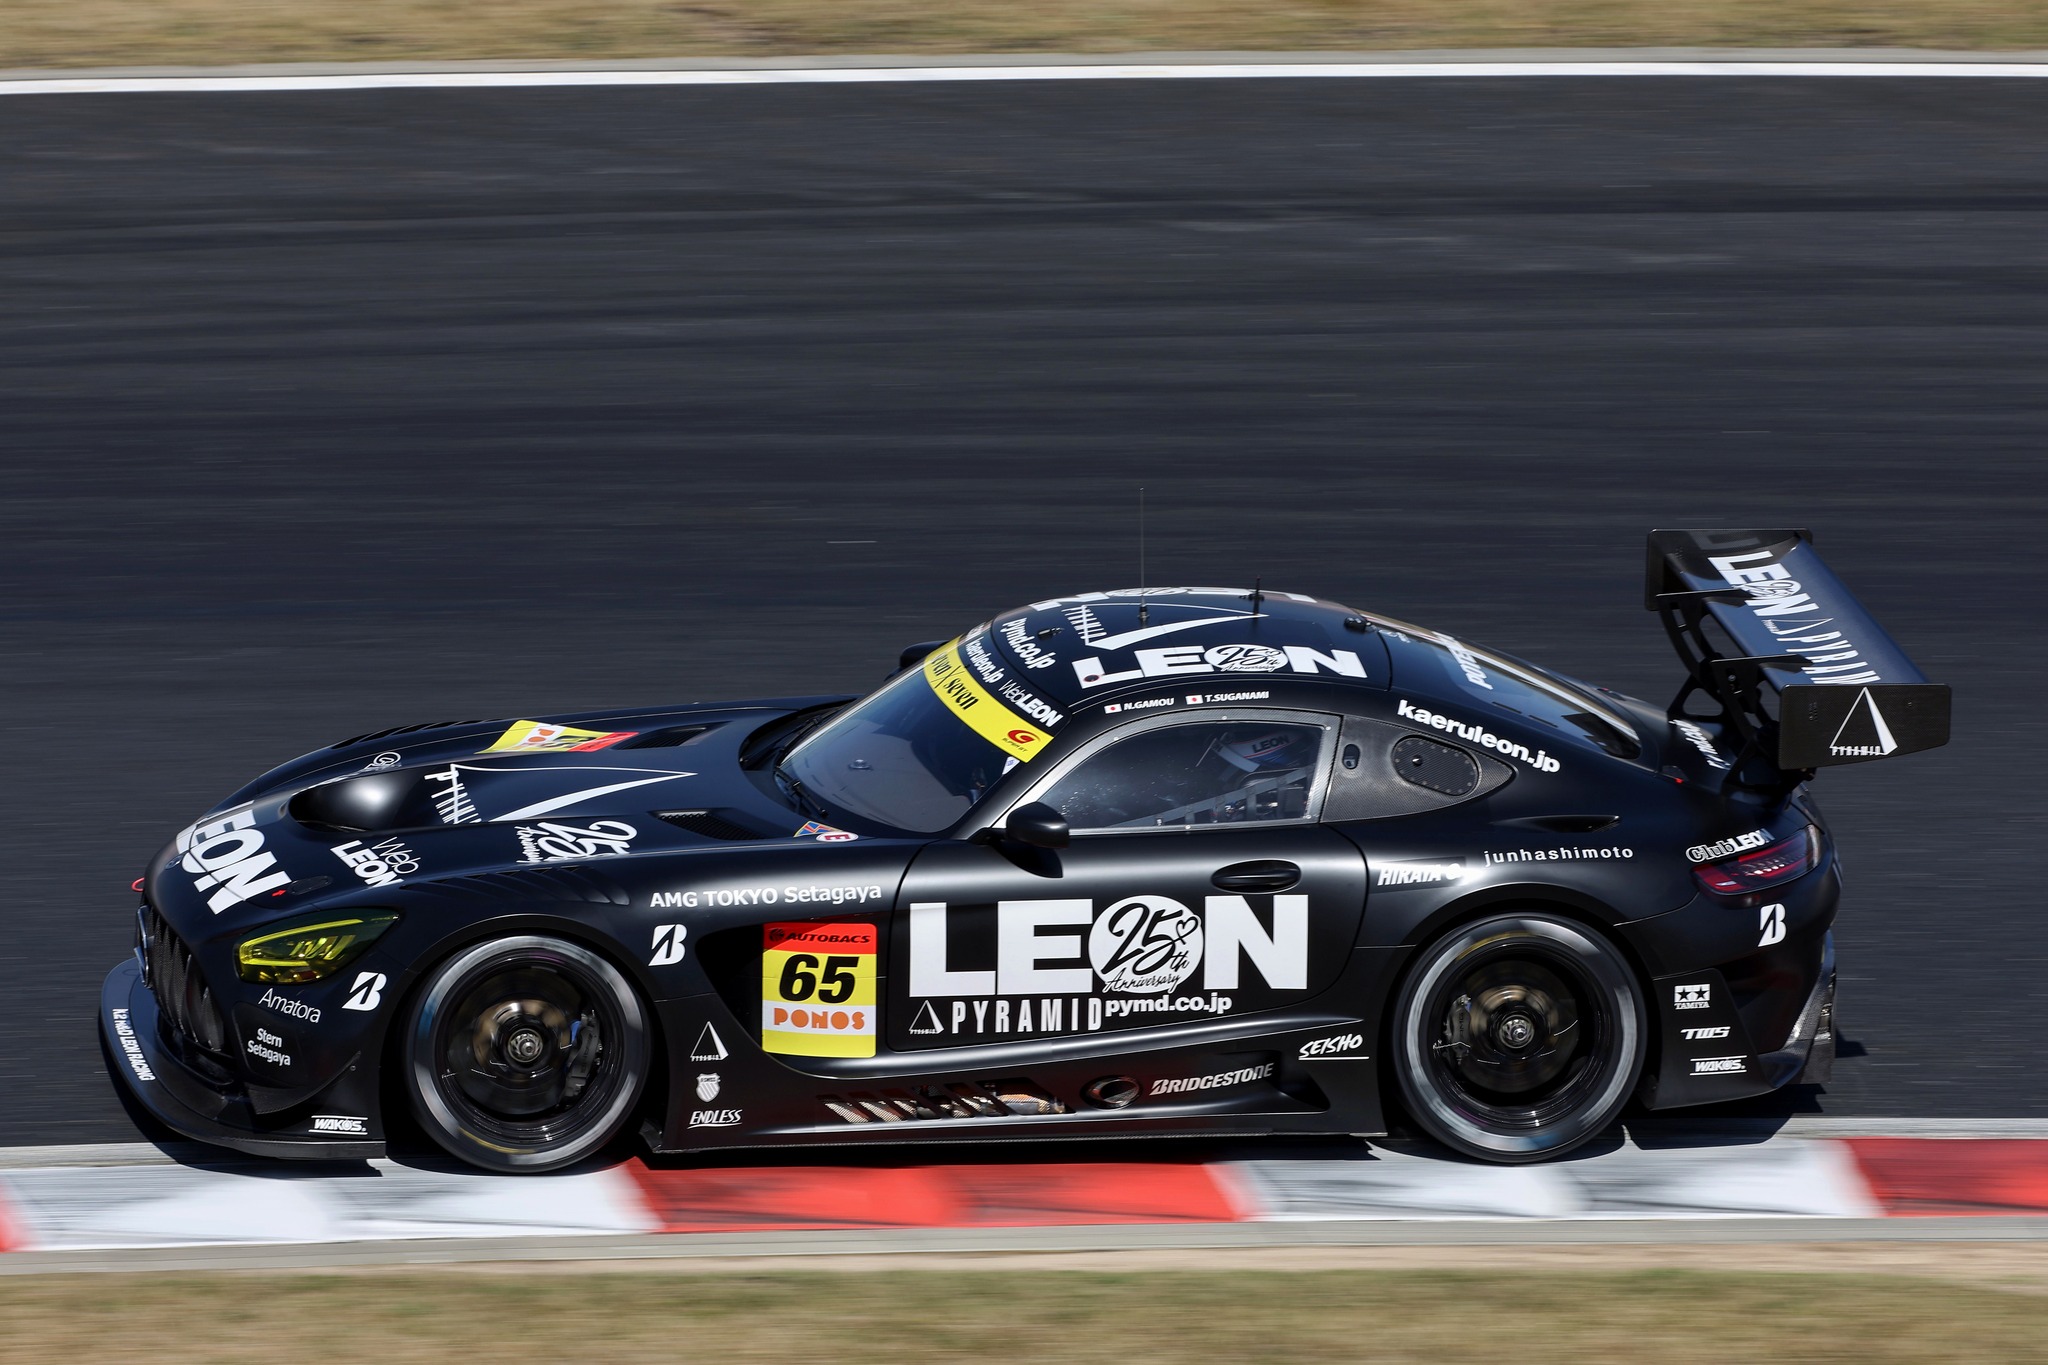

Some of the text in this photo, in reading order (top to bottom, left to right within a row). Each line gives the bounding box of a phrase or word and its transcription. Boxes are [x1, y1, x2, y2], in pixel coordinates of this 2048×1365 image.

[1776, 630, 1881, 685] PYRAM
[1123, 697, 1175, 711] N.GAMOU
[1204, 690, 1270, 703] T.SUGANAMI
[1396, 699, 1561, 773] kaeruleon.jp
[175, 800, 292, 915] EON
[329, 839, 405, 888] LEON
[371, 836, 422, 874] Web
[1484, 846, 1634, 868] junhashimoto
[1377, 864, 1442, 887] HIRATA
[650, 885, 883, 908] AMG TOKYO Setagaya
[785, 933, 871, 944] AUTOBACS
[909, 894, 1309, 997] LEON
[779, 953, 860, 1004] 65
[1102, 967, 1180, 993] Anniversary
[258, 987, 322, 1024] Amatora
[952, 997, 1103, 1035] PYRAMID
[1105, 993, 1233, 1017] pymd.co.jp
[773, 1007, 865, 1030] PONOS
[256, 1027, 283, 1048] Stern
[1299, 1034, 1363, 1059] SEISHO
[247, 1040, 291, 1067] Setagaya
[1149, 1062, 1274, 1096] BRIDGESTONE
[689, 1109, 743, 1126] ENDLESS
